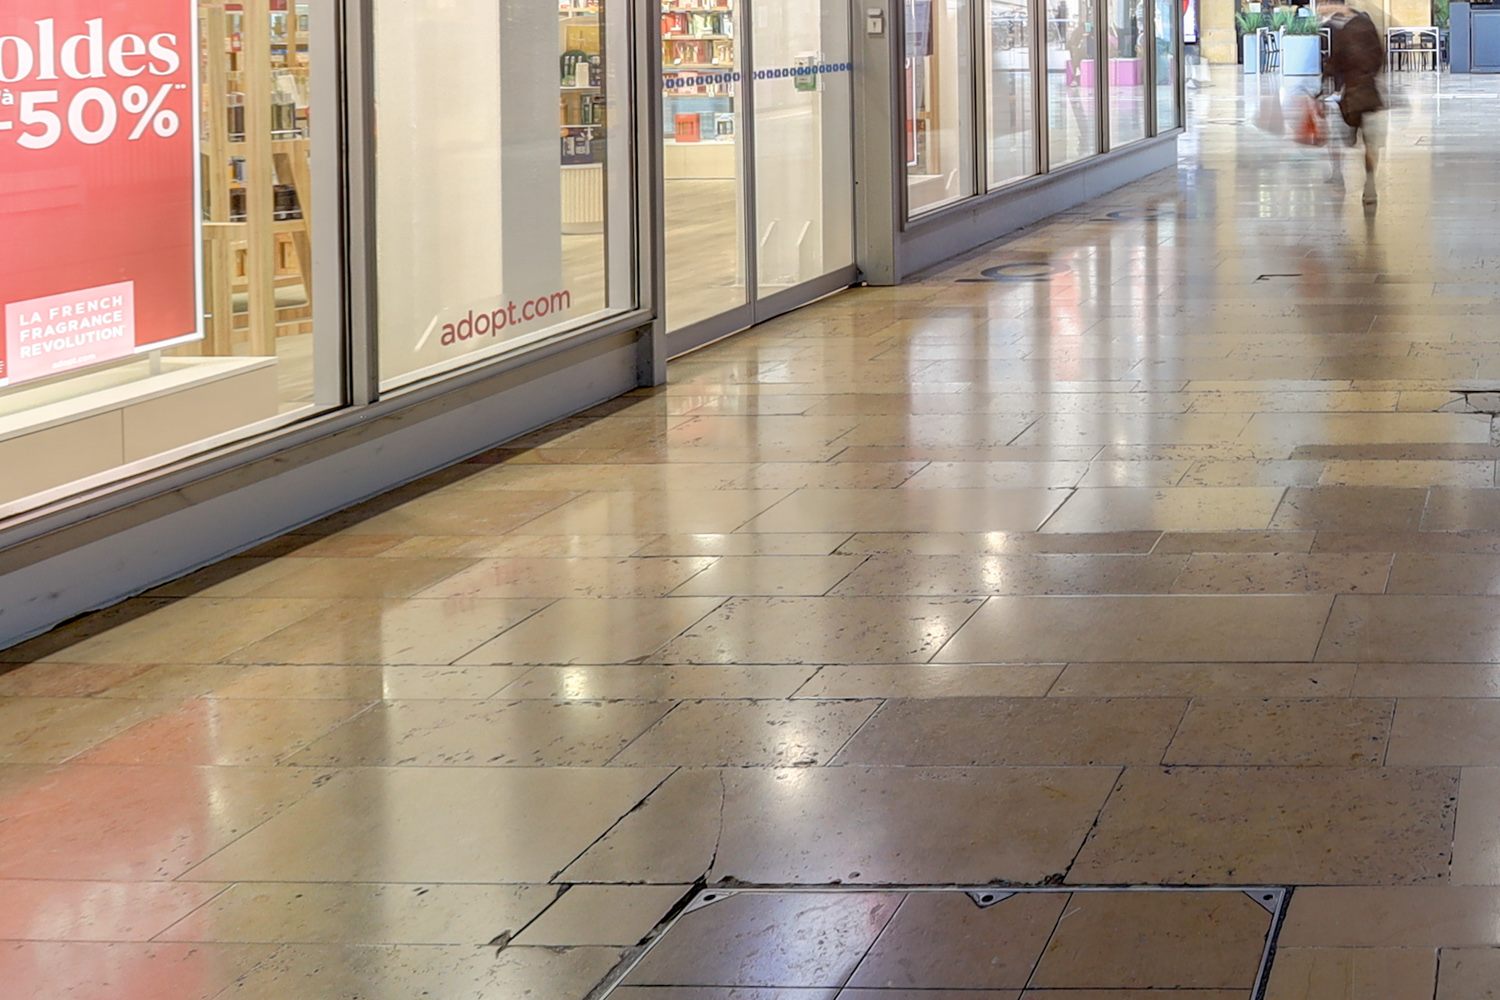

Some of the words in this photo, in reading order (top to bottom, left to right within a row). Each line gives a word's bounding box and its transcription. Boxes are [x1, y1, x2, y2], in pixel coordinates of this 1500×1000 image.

[19, 312, 42, 326] LA
[49, 295, 123, 320] FRENCH
[20, 310, 123, 342] FRAGRANCE
[441, 290, 570, 346] adopt.com
[20, 326, 124, 358] REVOLUTION
